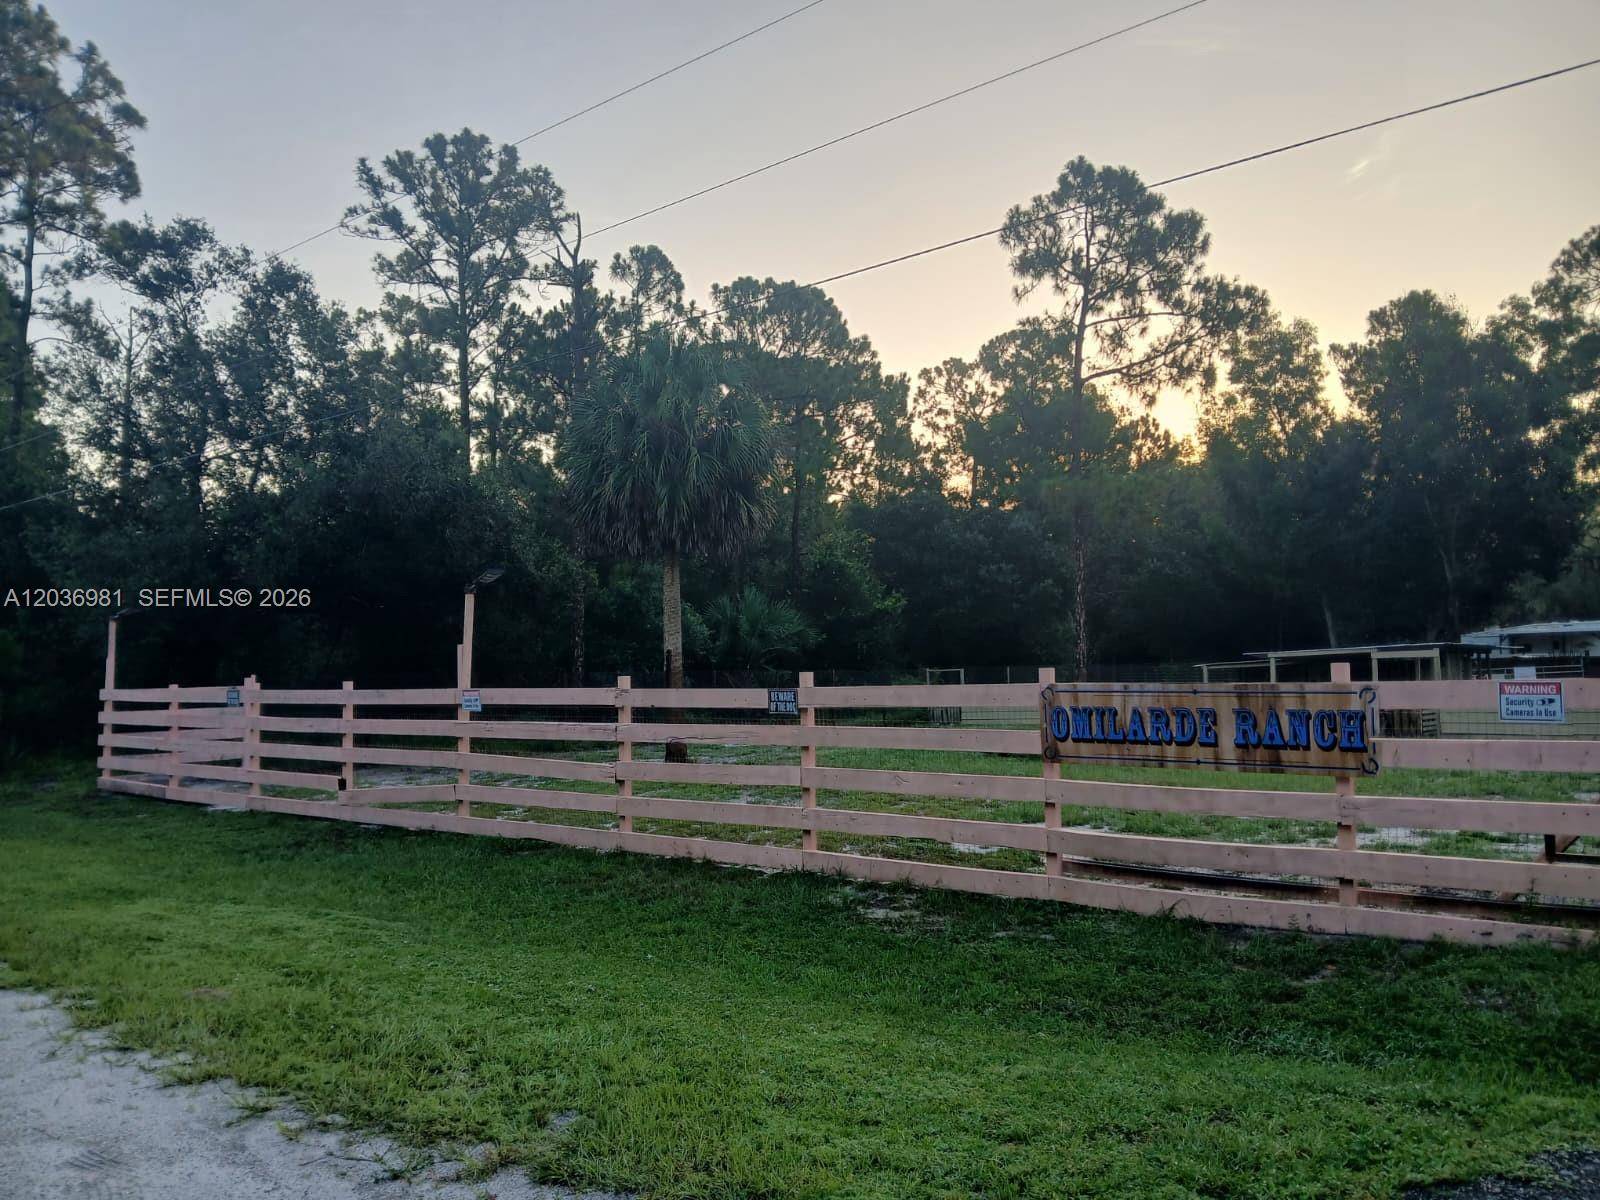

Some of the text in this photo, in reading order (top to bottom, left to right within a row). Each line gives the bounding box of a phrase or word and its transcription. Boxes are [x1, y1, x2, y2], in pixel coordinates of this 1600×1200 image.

[1504, 685, 1556, 694] WARNING
[770, 691, 795, 701] BEWARE
[1505, 697, 1534, 708] Security
[1506, 707, 1534, 717] Cameras
[1544, 708, 1556, 717] Use
[1051, 706, 1368, 753] OMILARDE RANCH
